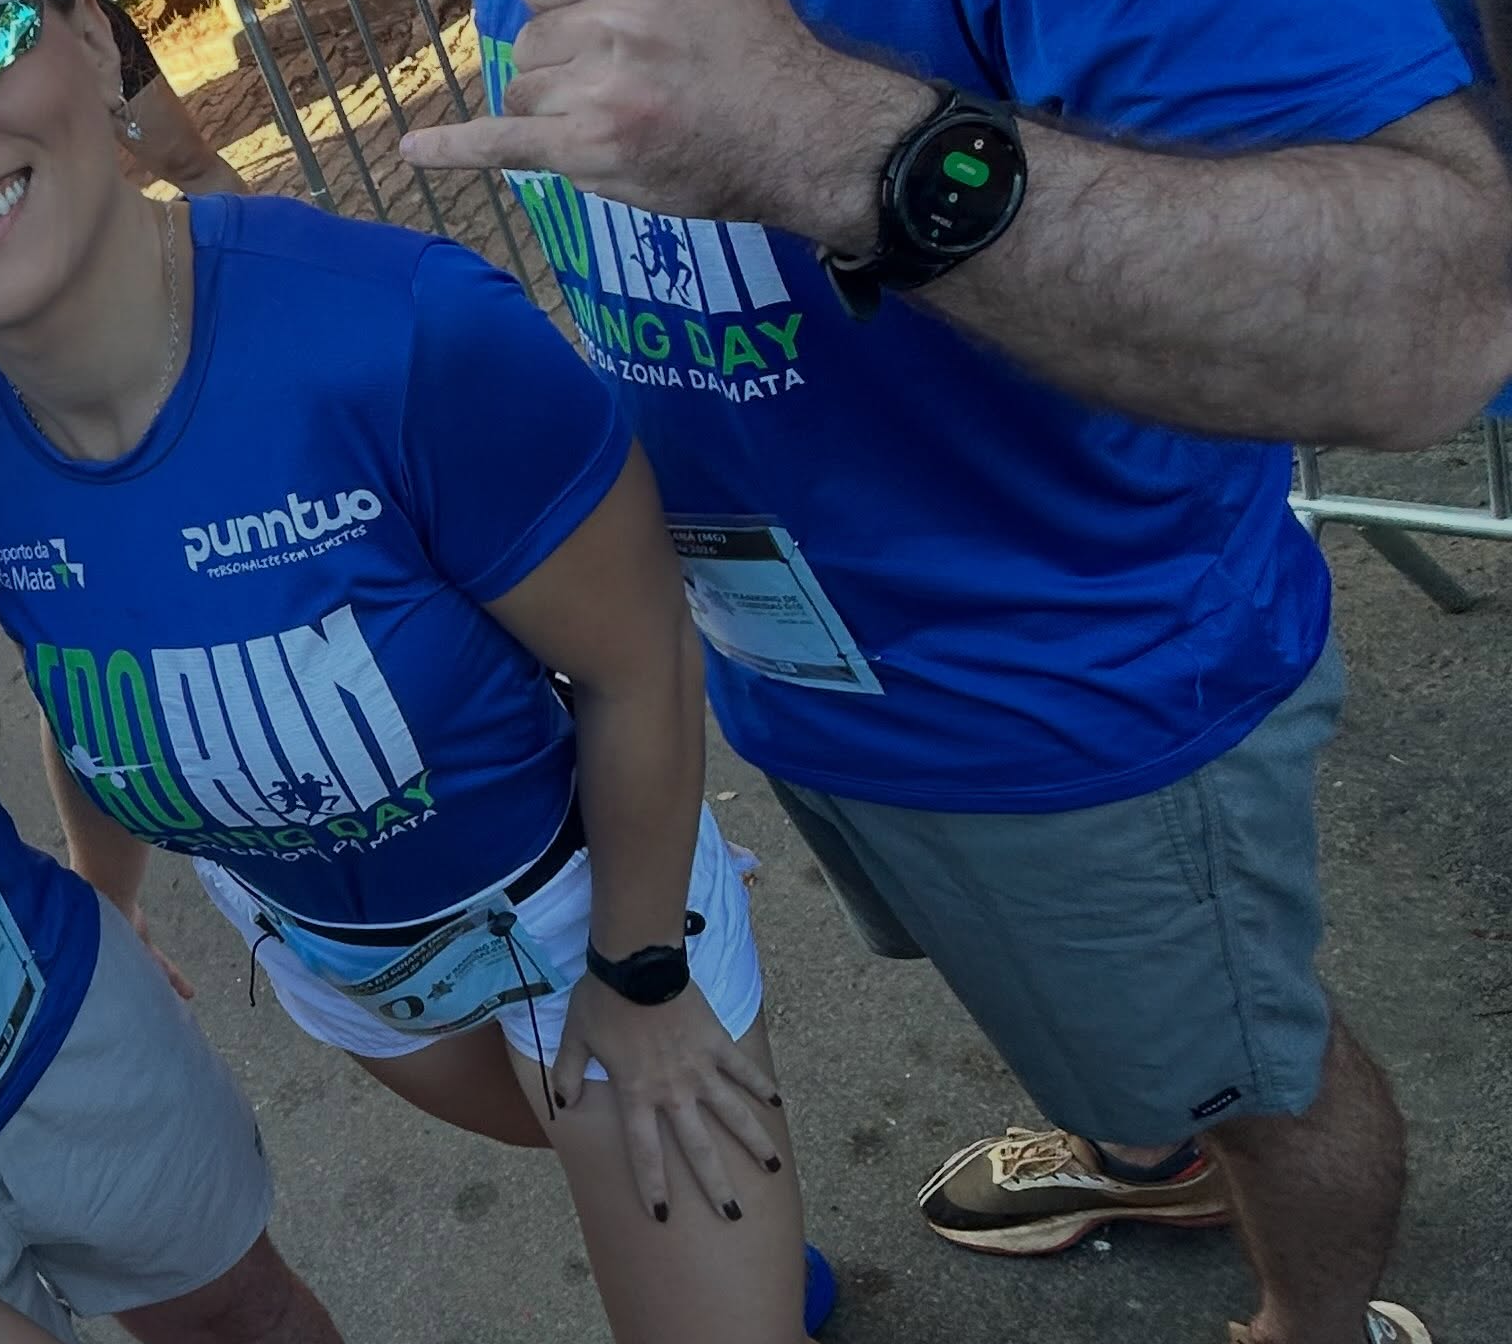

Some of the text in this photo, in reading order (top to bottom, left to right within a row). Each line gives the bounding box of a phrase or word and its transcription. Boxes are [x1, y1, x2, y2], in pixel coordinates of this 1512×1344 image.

[684, 313, 803, 376] DAY
[619, 360, 683, 387] ZONA
[688, 369, 722, 391] DA
[721, 367, 805, 402] MATA
[34, 540, 49, 559] da
[182, 489, 382, 572] punntuo
[11, 565, 56, 590] Mata
[370, 809, 437, 849] MATA
